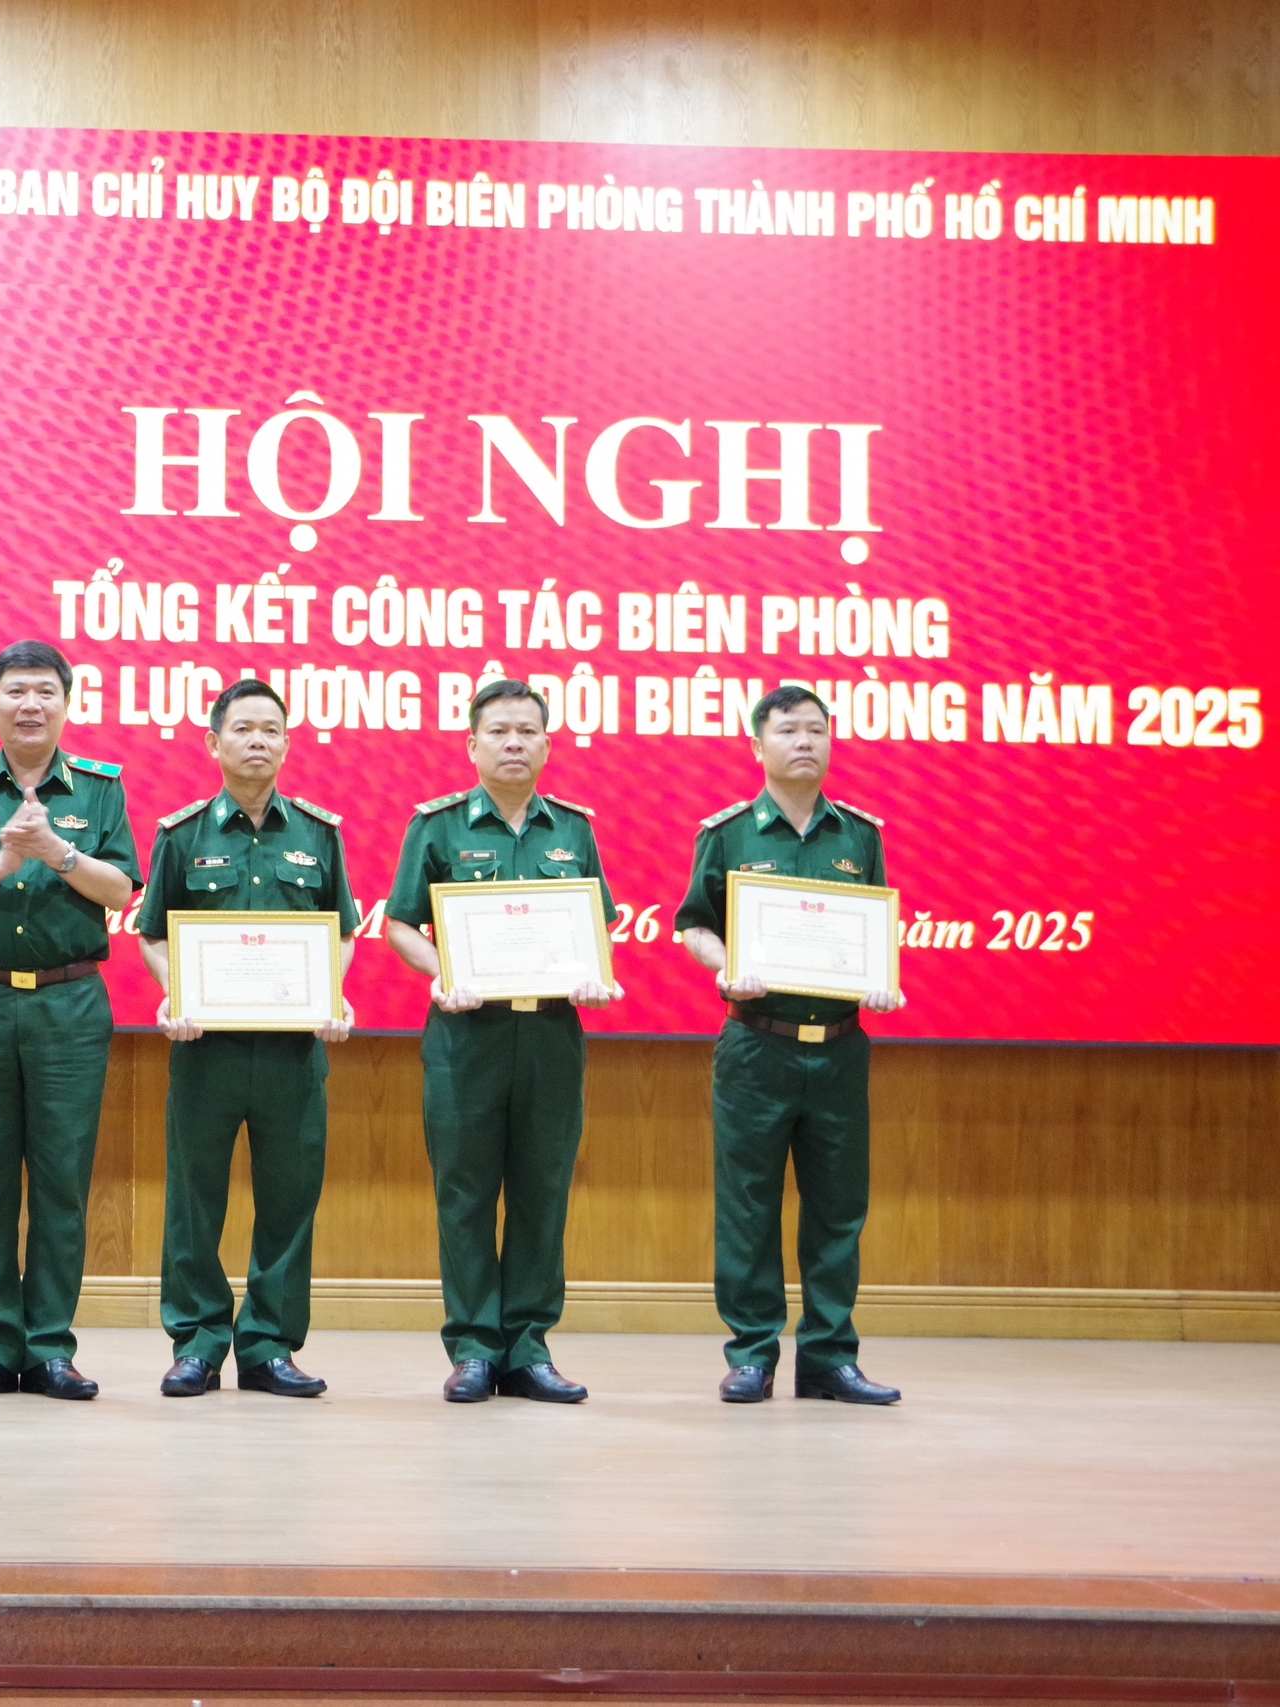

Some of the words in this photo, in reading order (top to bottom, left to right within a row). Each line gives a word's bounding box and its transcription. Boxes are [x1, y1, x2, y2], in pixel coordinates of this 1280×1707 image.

[91, 157, 165, 219] CHỈ
[176, 174, 260, 221] HUY
[272, 166, 329, 233] BỘ
[340, 168, 413, 235] ĐỘI
[426, 172, 526, 229] BIÊN
[537, 173, 684, 233] PHÒNG
[693, 179, 835, 237] THÀNH
[847, 177, 936, 239] PHỐ
[945, 179, 1003, 241] HỒ
[1014, 186, 1087, 243] CHÍ
[1098, 197, 1214, 245] MINH
[120, 390, 425, 552] HỘI
[467, 414, 883, 565] NGHỊ
[52, 557, 199, 643] TỔNG
[215, 563, 317, 645] KẾT
[332, 574, 483, 649] CÔNG
[498, 578, 602, 652] TÁC
[618, 581, 746, 655] BIÊN
[762, 582, 949, 659] PHÒNG
[239, 663, 422, 744] ƯỢNG
[779, 666, 967, 742] HÒNG
[983, 672, 1112, 745] NĂM
[1127, 686, 1262, 748] 2025
[610, 903, 662, 943] 26
[986, 910, 1095, 952] 2025
